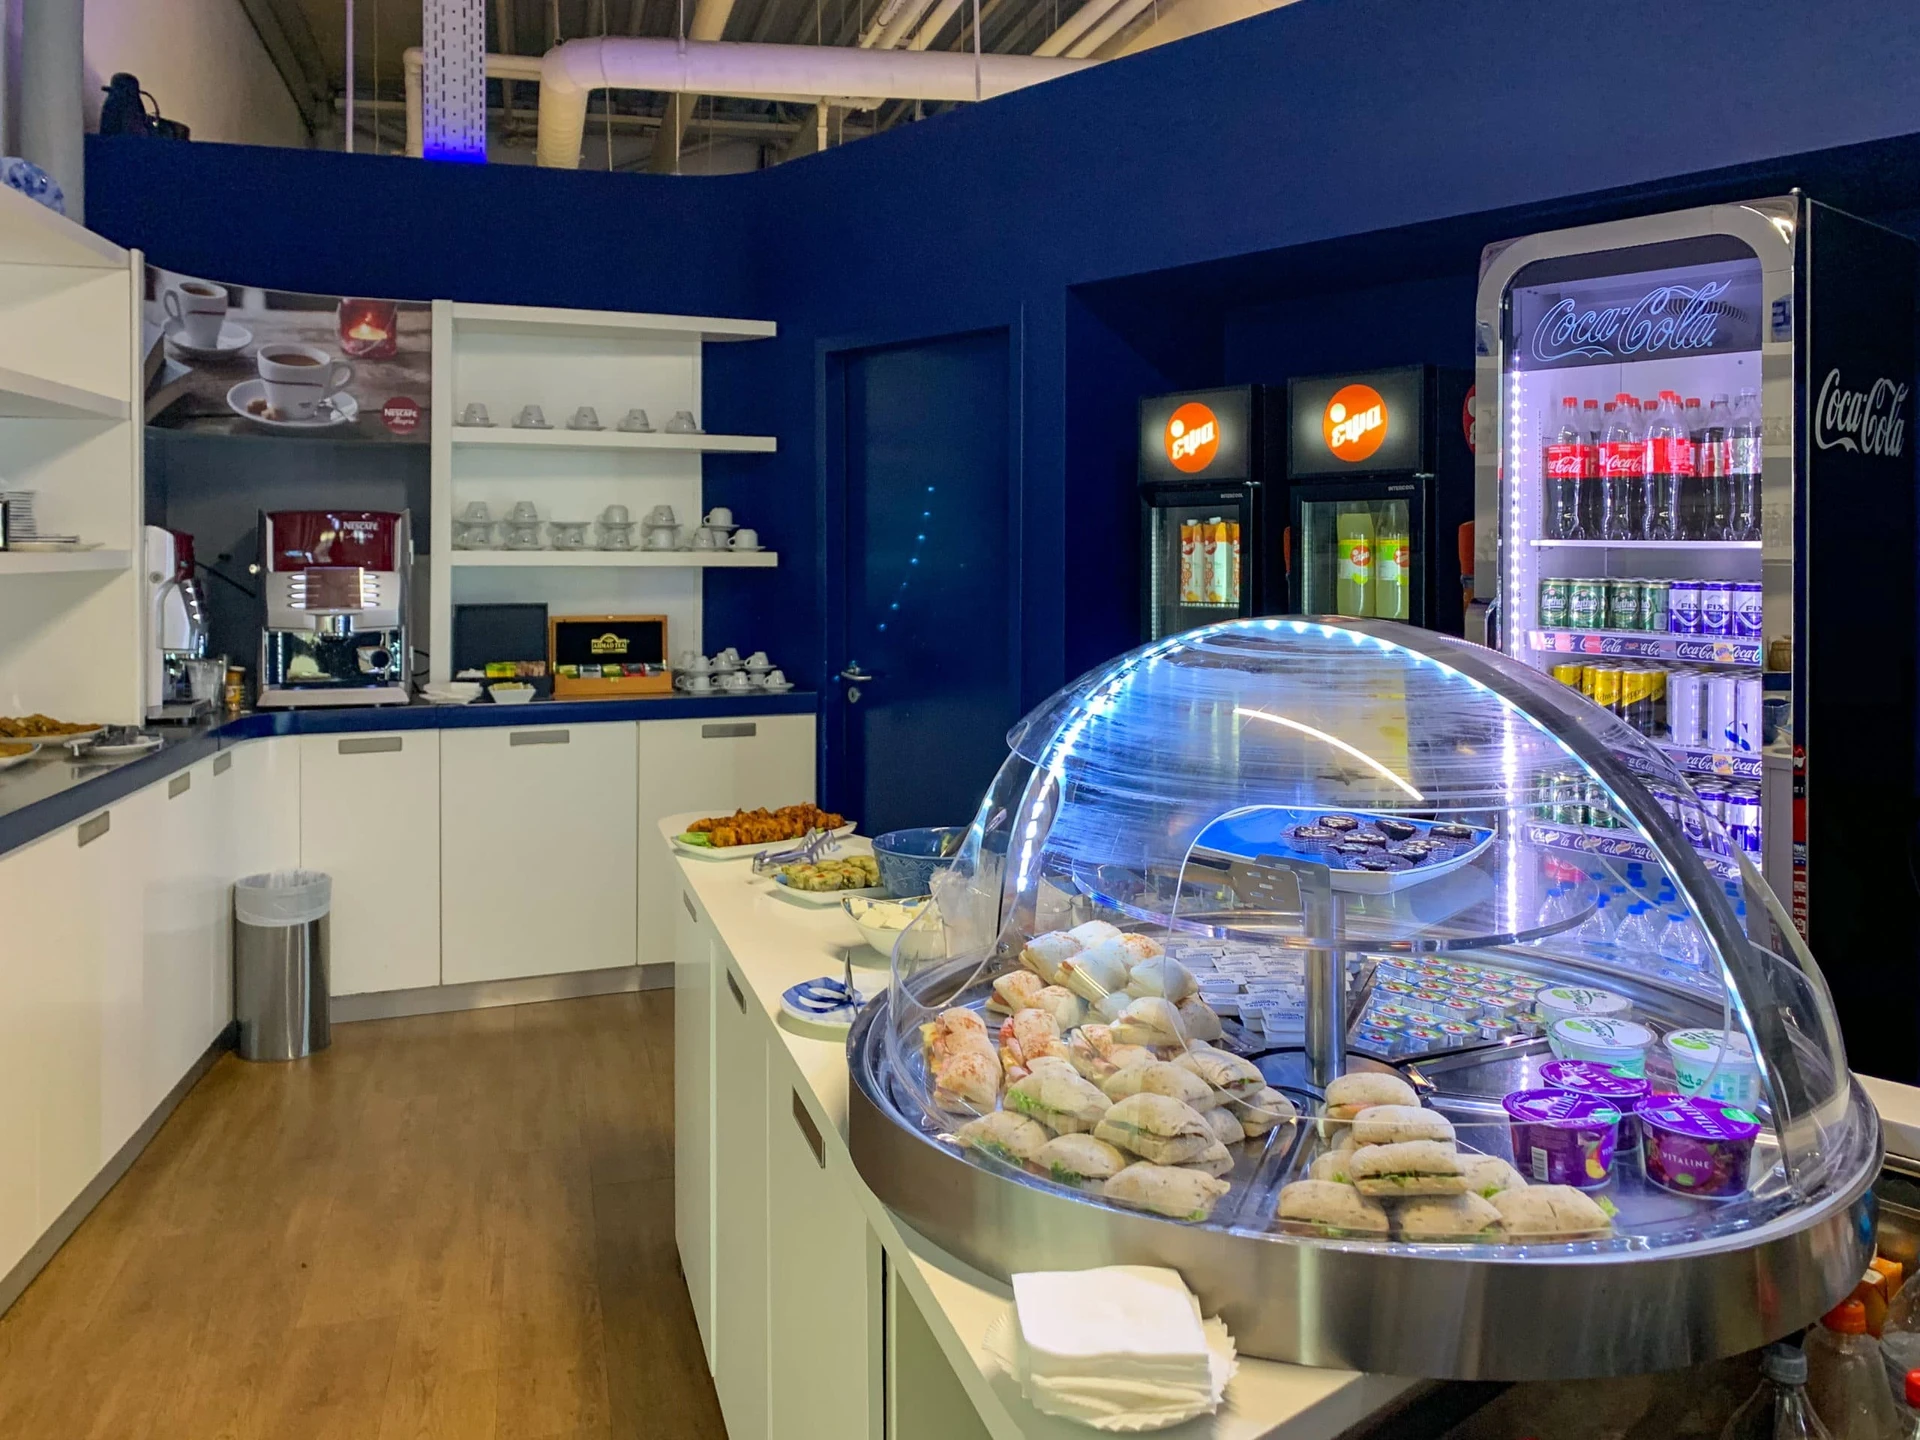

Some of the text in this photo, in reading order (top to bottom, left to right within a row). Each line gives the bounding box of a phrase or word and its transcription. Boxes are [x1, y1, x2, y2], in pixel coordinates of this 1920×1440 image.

[1532, 279, 1732, 362] Coca-Cola
[1815, 367, 1909, 457] Coca-Cola
[1661, 1151, 1710, 1169] VITALINE
